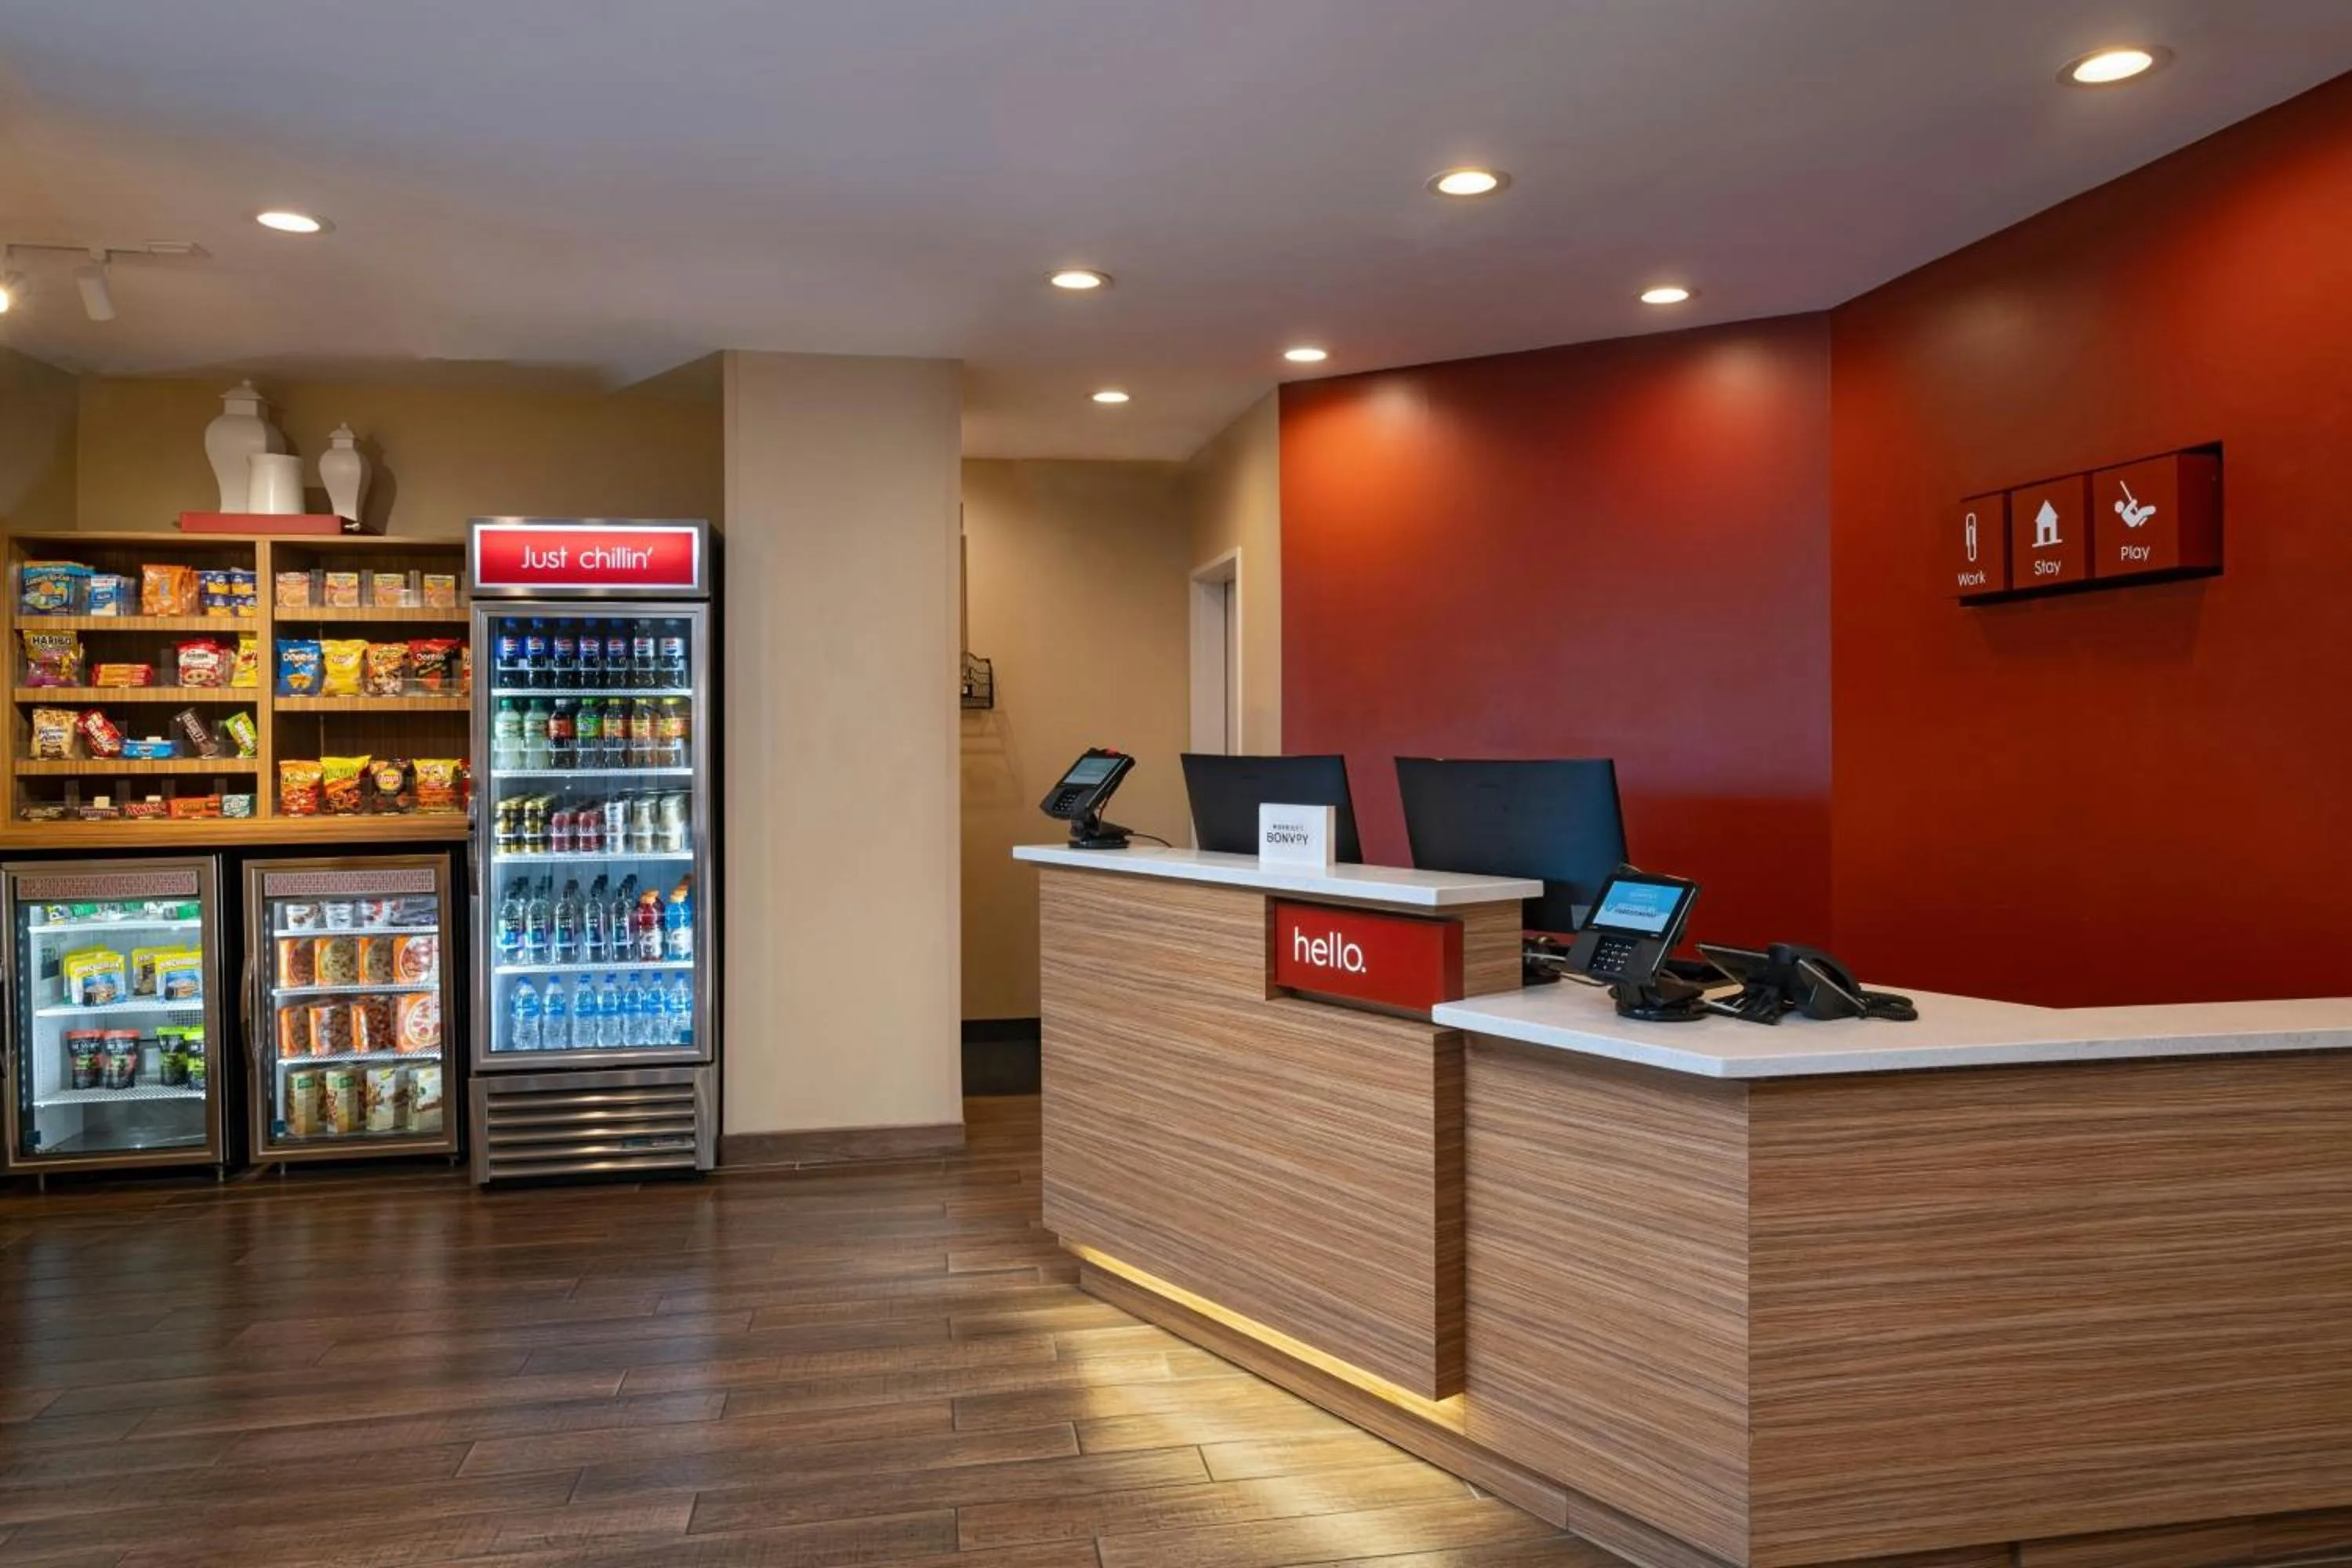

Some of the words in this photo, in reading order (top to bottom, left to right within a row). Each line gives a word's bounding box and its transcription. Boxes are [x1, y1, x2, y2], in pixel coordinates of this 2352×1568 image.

[521, 546, 568, 568] Just
[579, 546, 653, 569] chillin'
[2120, 546, 2151, 562] Play
[2034, 559, 2062, 576] Stay
[1957, 571, 1987, 586] Work
[32, 636, 72, 645] HARIBO
[1294, 926, 1367, 973] hello.
